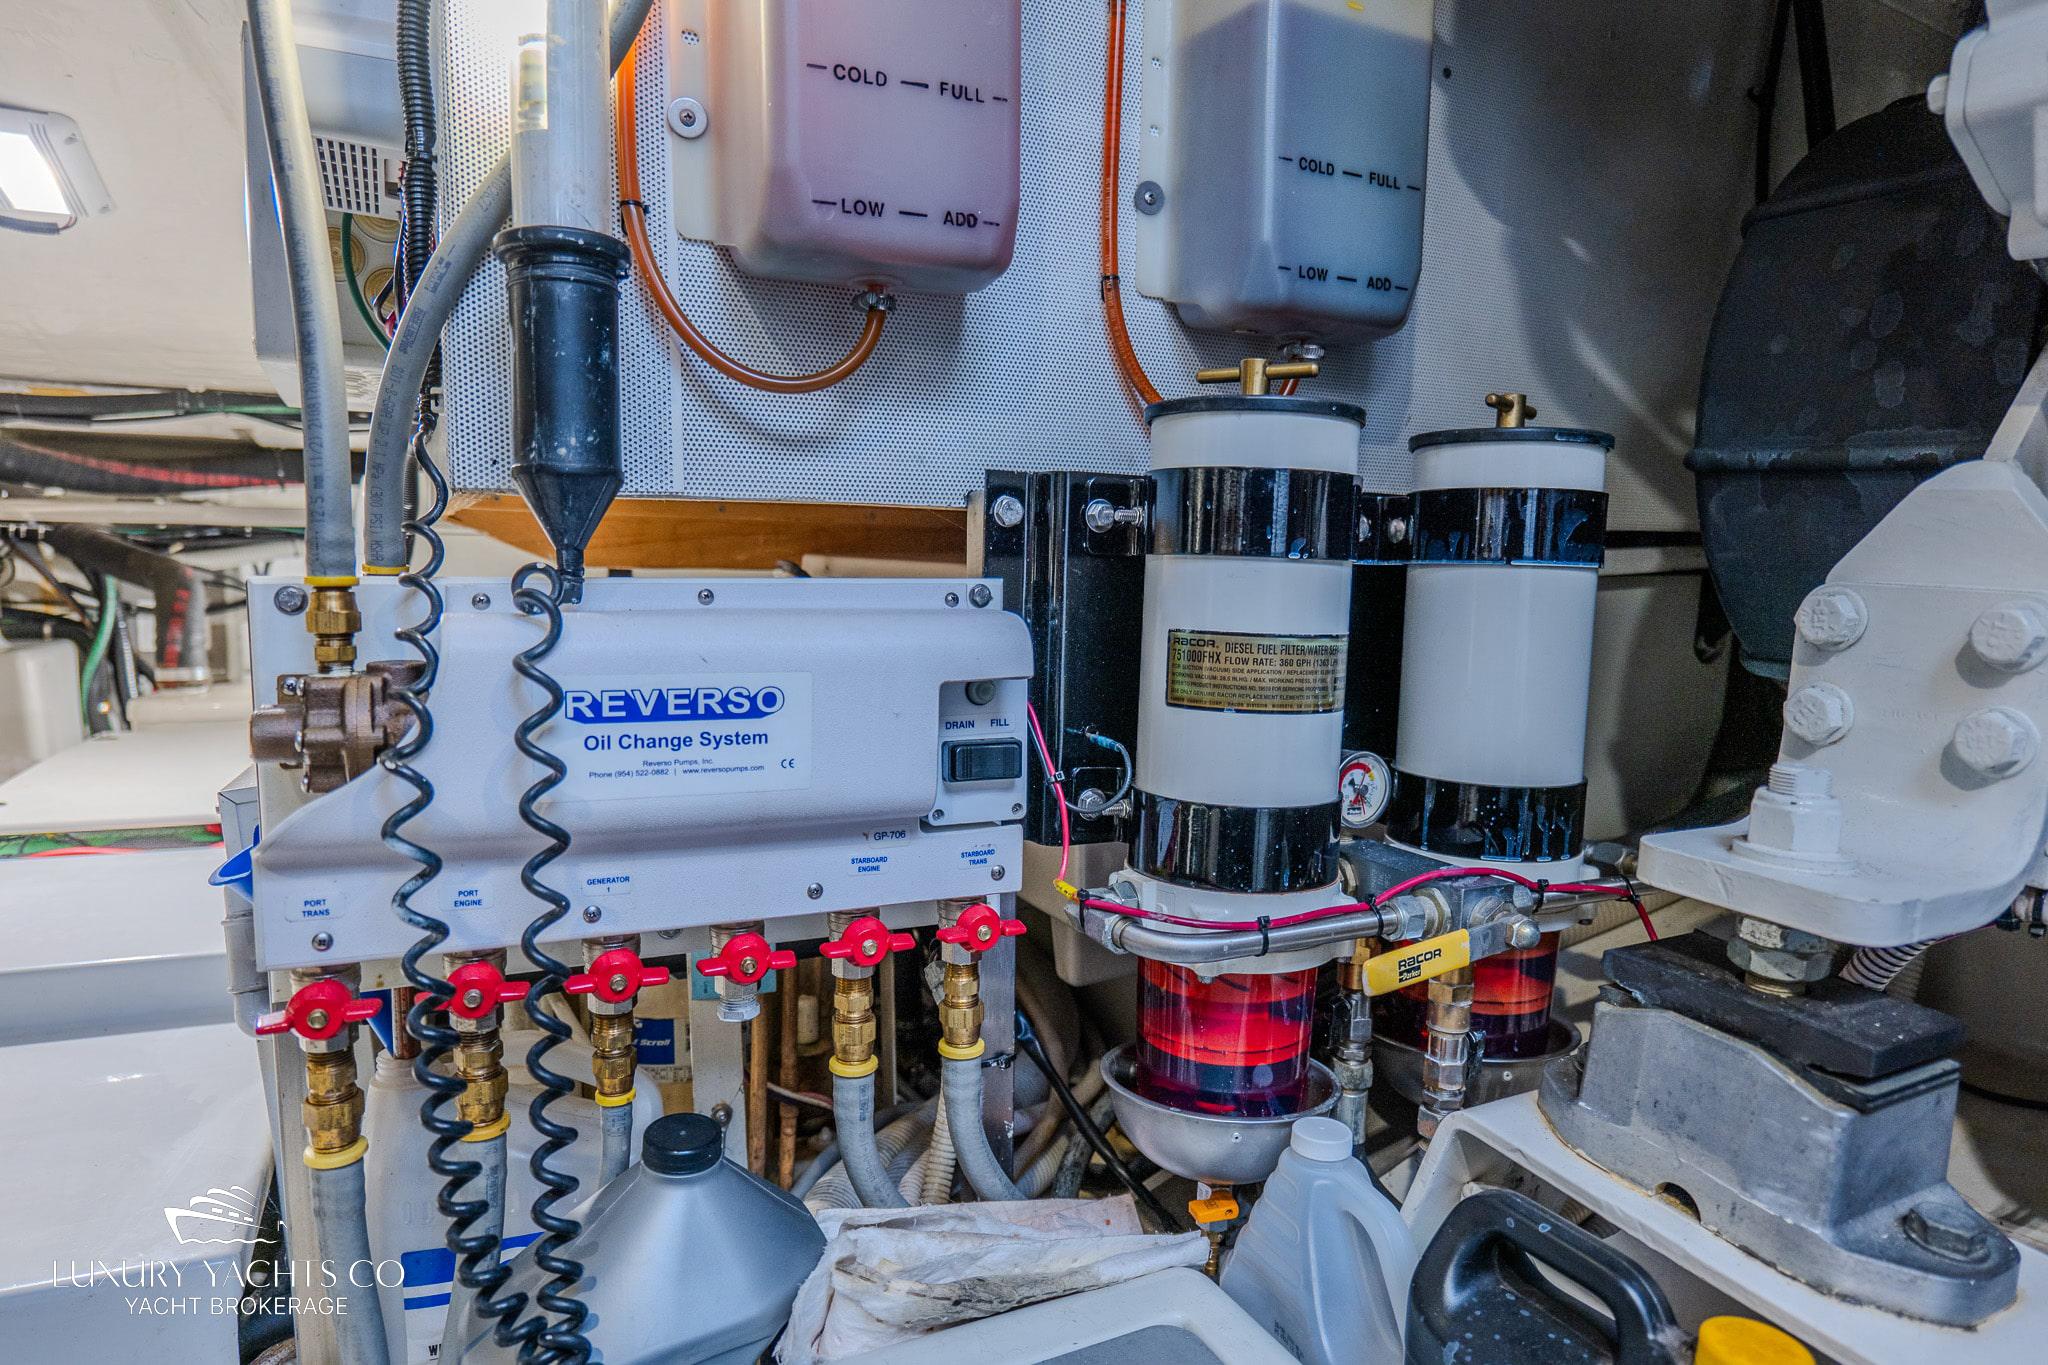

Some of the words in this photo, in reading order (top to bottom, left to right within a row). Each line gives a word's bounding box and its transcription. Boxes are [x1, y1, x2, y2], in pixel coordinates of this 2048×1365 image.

[833, 64, 887, 87] COLD
[940, 82, 985, 103] FULL
[1299, 157, 1335, 176] COLD
[1369, 172, 1401, 190] FULL
[841, 198, 885, 217] LOW
[943, 210, 978, 228] ADD
[1298, 265, 1328, 282] LOW
[1367, 277, 1392, 292] ADD
[1224, 641, 1255, 655] DIESEL
[1257, 643, 1278, 656] FUEL
[1224, 656, 1250, 666] FLOW
[1252, 657, 1277, 667] RATE:
[1280, 658, 1294, 667] 360
[1296, 658, 1312, 668] GPH
[565, 686, 785, 724] REVERSO
[945, 720, 975, 730] DRAIN
[990, 718, 1010, 728] FILL
[584, 734, 611, 751] Oil
[618, 733, 693, 752] Change
[699, 731, 768, 750] System
[614, 770, 634, 779] (954)
[682, 764, 765, 775] www.reversopumps.com
[873, 830, 907, 841] GP-706
[960, 849, 996, 858] STARBOARD
[851, 856, 888, 865] STARBOARD
[968, 857, 988, 866] TRANS
[857, 865, 881, 873] ENGINE
[586, 876, 630, 886] GENERATOR
[457, 889, 479, 897] PORT
[303, 899, 327, 908] PORT
[454, 899, 483, 908] ENGINE
[302, 908, 331, 918] TRANS
[639, 1038, 672, 1047] Scroll
